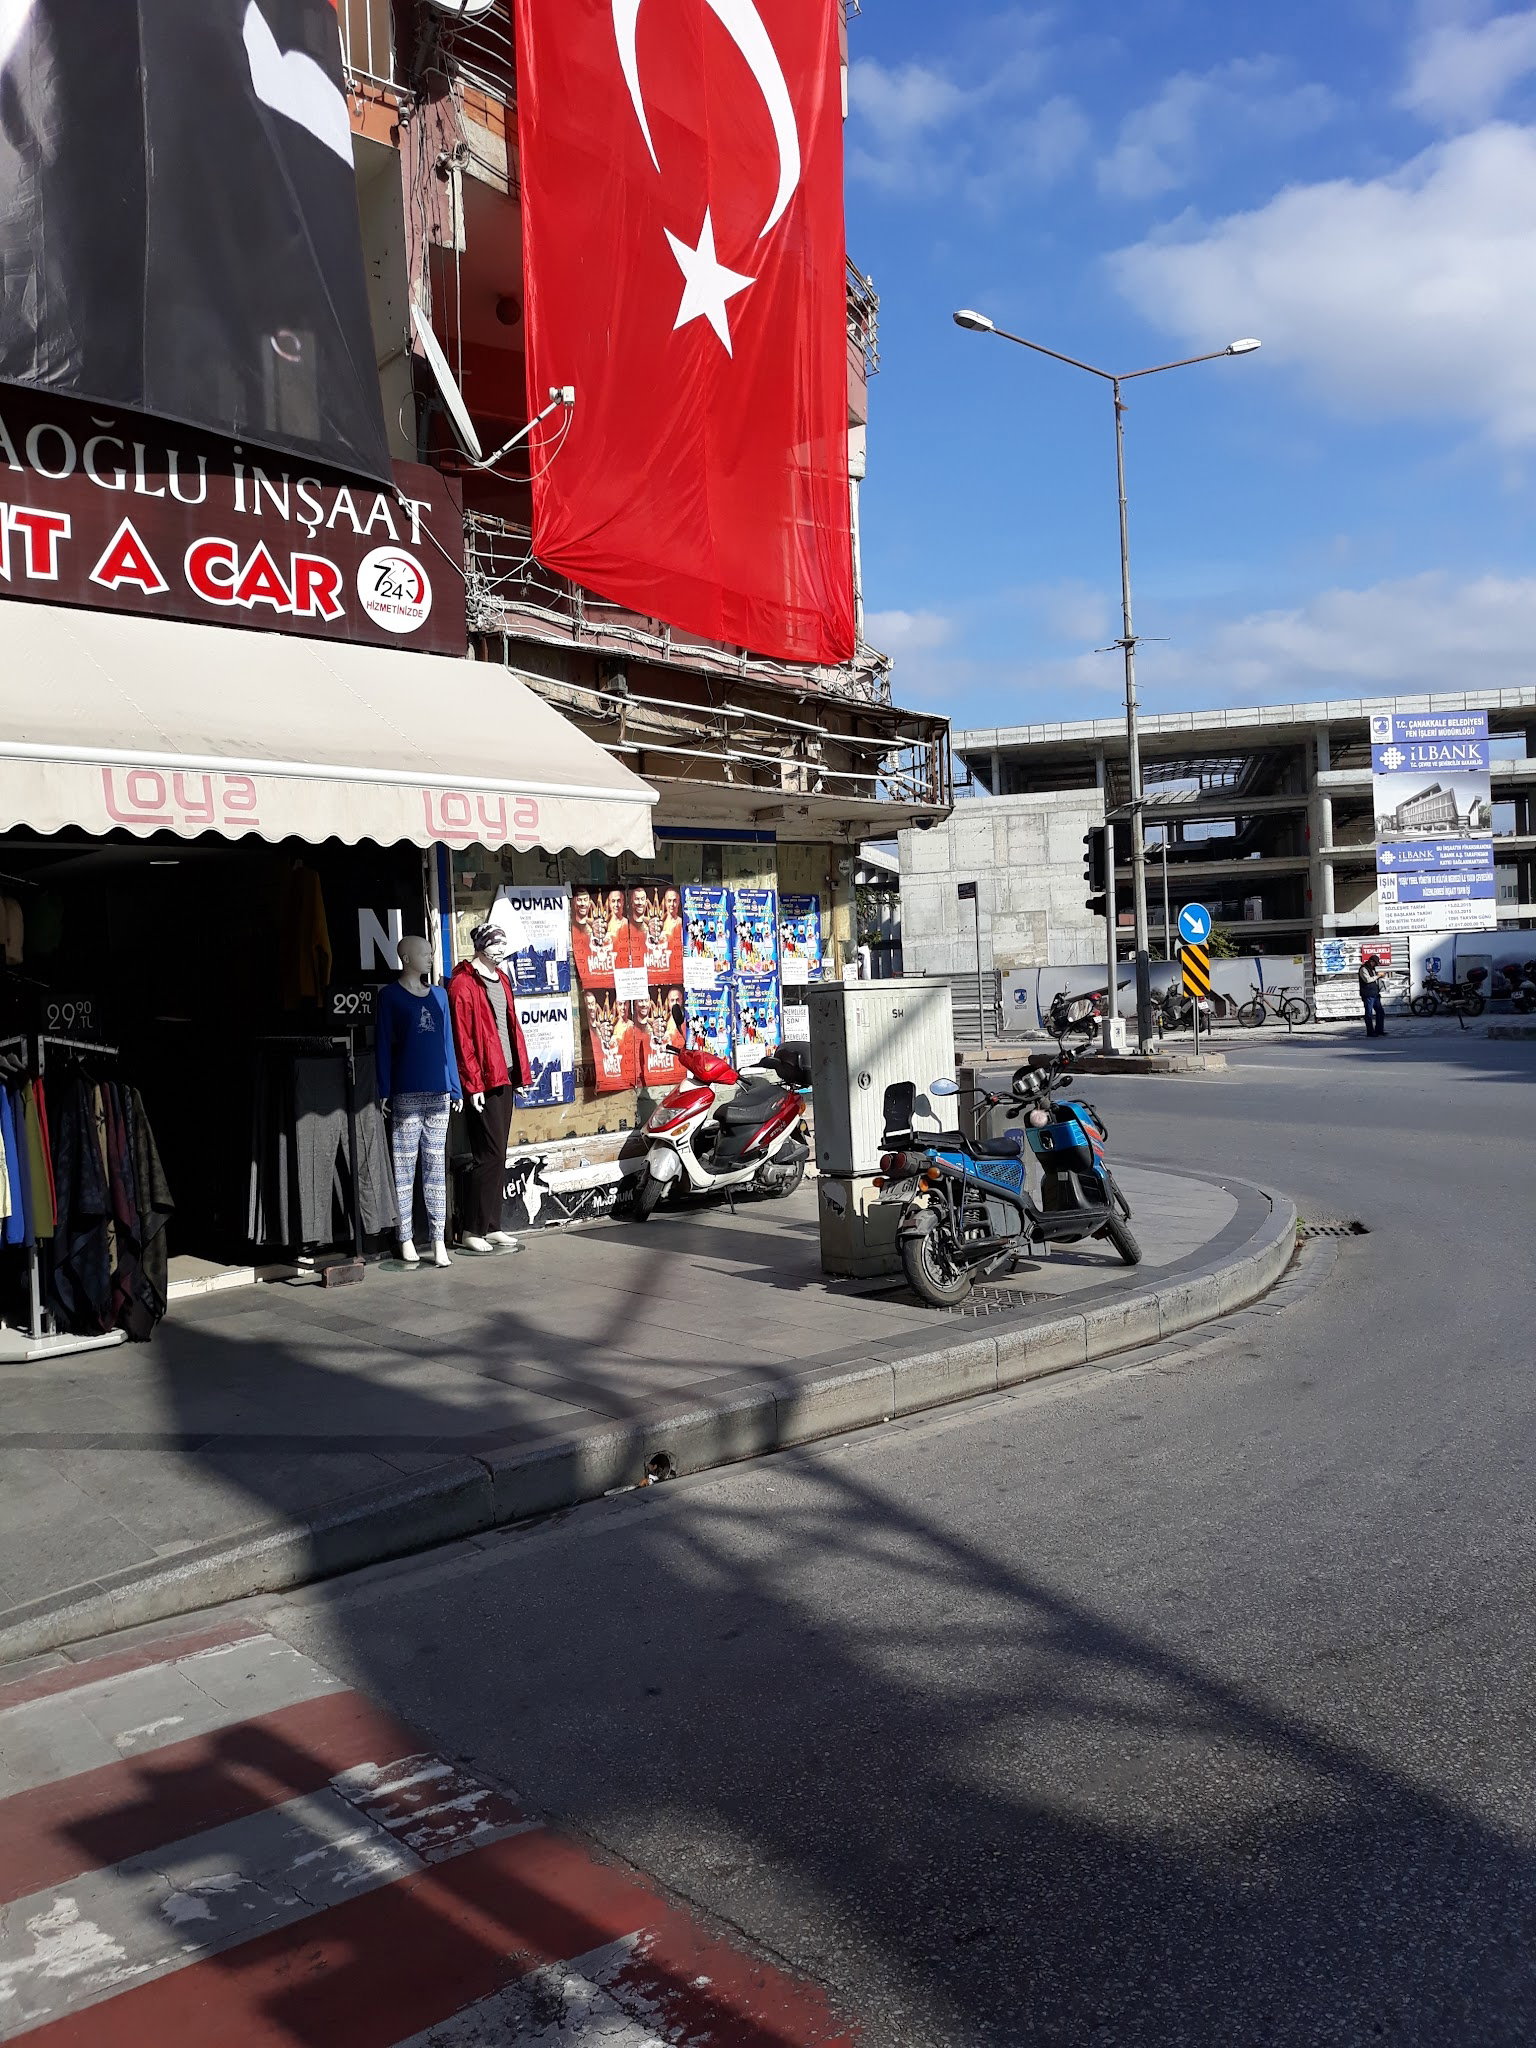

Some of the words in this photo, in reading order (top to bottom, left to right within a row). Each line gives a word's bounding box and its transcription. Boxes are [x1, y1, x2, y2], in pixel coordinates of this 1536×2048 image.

[233, 445, 432, 545] İNŞAAT
[89, 516, 170, 595] A
[184, 537, 346, 622] CAR
[367, 600, 424, 618] HİZMETİNİZDE
[1409, 719, 1447, 729] ÇANAKKALE
[1448, 716, 1484, 726] BELEDİYESİ
[1406, 730, 1417, 738] FEN
[1418, 728, 1437, 738] İŞLERİ
[1438, 726, 1475, 736] MÜDÜRLÜĞÜ
[1379, 877, 1396, 888] İŞİN
[1381, 891, 1395, 900] ADI
[511, 896, 564, 911] DUMAN
[521, 1008, 568, 1024] DUMAN
